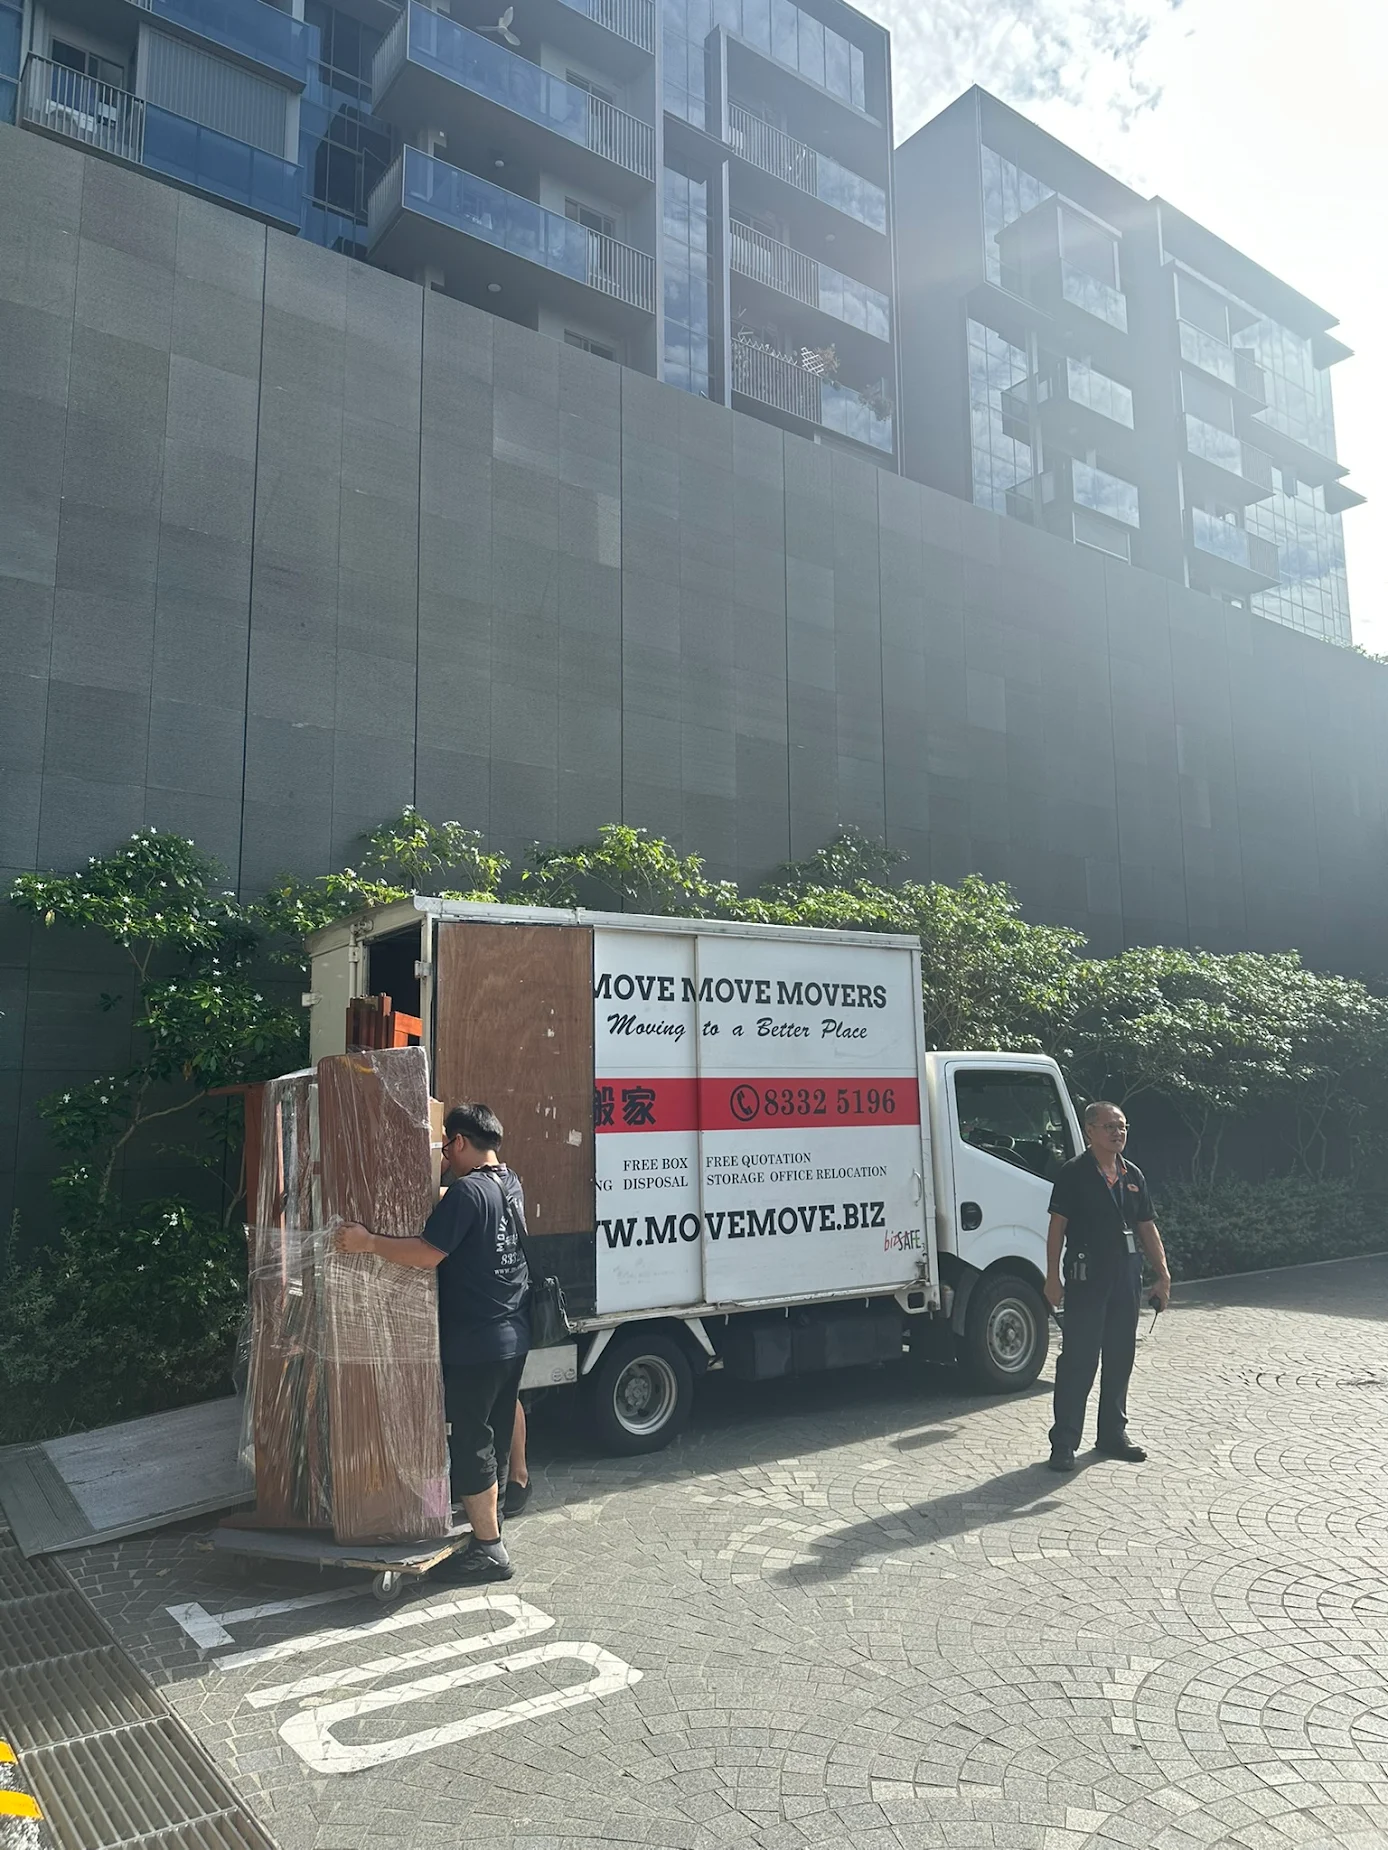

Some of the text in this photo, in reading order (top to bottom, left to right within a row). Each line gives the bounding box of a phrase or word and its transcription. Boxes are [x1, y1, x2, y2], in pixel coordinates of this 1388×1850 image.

[681, 978, 771, 1004] MOVE
[777, 981, 887, 1008] MOVERS
[607, 1013, 867, 1042] Moving to a Better Place
[765, 1089, 896, 1116] 8332 5196
[623, 1157, 689, 1171] FREE BOX
[705, 1152, 812, 1168] FREE QUOTATION
[623, 1176, 689, 1191] DISPOSAL
[706, 1165, 887, 1186] STORAGE OFFICE RELOCATION
